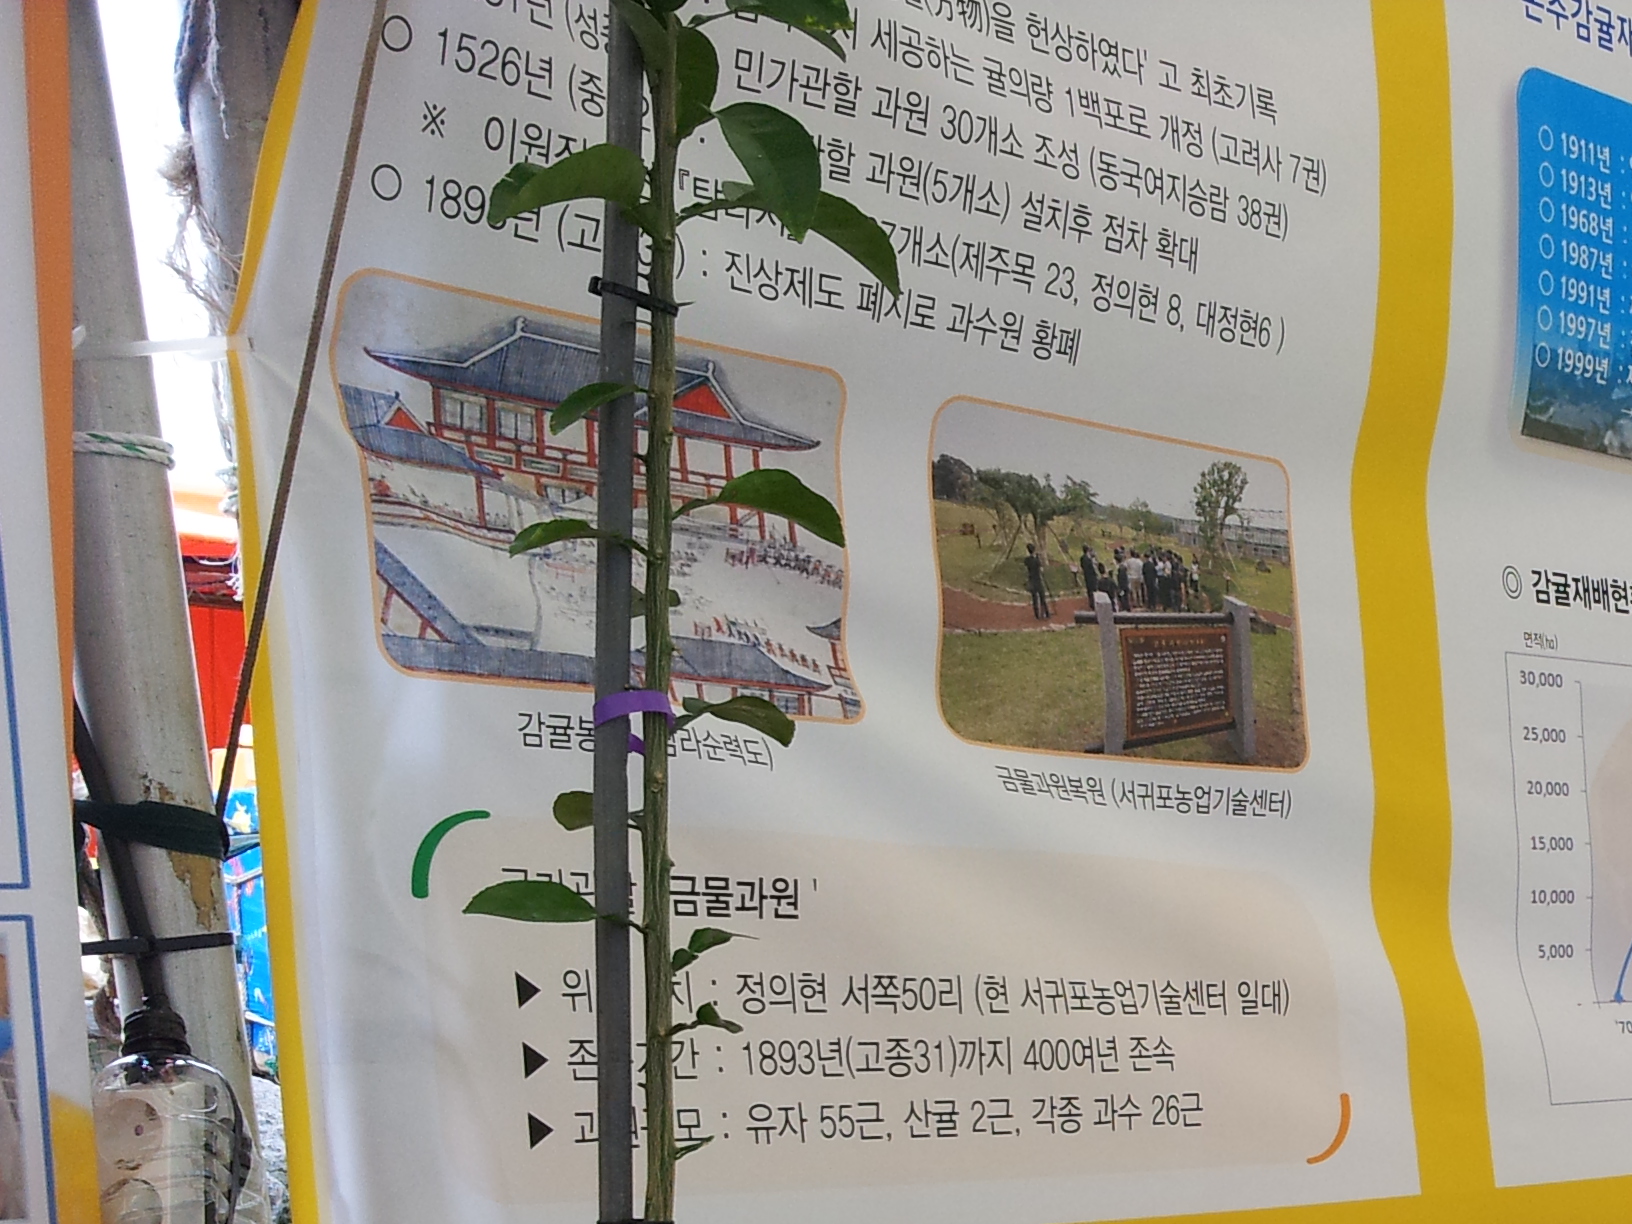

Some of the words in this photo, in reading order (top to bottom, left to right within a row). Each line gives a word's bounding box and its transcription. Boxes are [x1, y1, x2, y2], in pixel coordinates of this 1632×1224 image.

[871, 19, 974, 86] 세공하는
[983, 57, 1053, 113] 귤의량
[1066, 87, 1151, 138] 1백포로
[1160, 115, 1203, 158] 개정
[1212, 127, 1282, 182] (고려사
[1290, 154, 1326, 196] 7권)
[1159, 60, 1181, 92] 고
[1191, 68, 1277, 125] 최초기록
[438, 28, 552, 100] 1526년
[866, 152, 1009, 224] 과원(5개소)
[1021, 191, 1092, 243] 설치후
[1103, 214, 1148, 260] 점차
[1156, 228, 1198, 274] 확대
[735, 49, 862, 117] 민가관할
[872, 87, 929, 136] 과원
[941, 105, 1024, 159] 30개소
[1034, 134, 1079, 179] 조성
[1090, 146, 1229, 223] (동국여지승람
[1238, 195, 1287, 241] 38권)
[1561, 133, 1610, 173] 1911년
[1561, 169, 1611, 209] 1913년
[1562, 203, 1612, 244] 1968년
[1562, 240, 1612, 279] 1987년
[725, 251, 844, 309] 진상제도
[857, 276, 935, 330] 폐지로
[946, 303, 1024, 352] 과수원
[1032, 320, 1081, 366] 황폐
[1045, 263, 1077, 306] 23,
[1092, 273, 1159, 323] 정의현
[1167, 294, 1183, 332] 8,
[1561, 276, 1610, 314] 1991년
[1560, 311, 1610, 349] 1997년
[1520, 670, 1562, 688] 30,000
[1524, 726, 1566, 743] 25,000
[995, 766, 1107, 806] 금물과원복원
[1112, 778, 1291, 819] (서귀포농업기술센터)
[1527, 781, 1569, 797] 20,000
[1531, 836, 1573, 852] 15,000
[1532, 890, 1574, 905] 10,000
[1539, 944, 1573, 960] 5,000
[737, 972, 827, 1014] 정의현
[842, 974, 962, 1014] 서쪽50리
[976, 974, 1009, 1015] (현
[1021, 977, 1227, 1015] 서귀포농업기술센터
[1238, 979, 1289, 1016] 일대)
[743, 1036, 1011, 1079] 1893년(고종31)까지
[1024, 1036, 1119, 1073] 400여년
[1129, 1036, 1175, 1071] 존속
[746, 1102, 807, 1144] 유자
[821, 1102, 891, 1141] 55근,
[904, 1099, 959, 1138] 산귤
[971, 1099, 1019, 1136] 2근,
[1033, 1096, 1082, 1133] 각종
[1094, 1094, 1142, 1131] 과수
[1152, 1093, 1203, 1127] 26근
